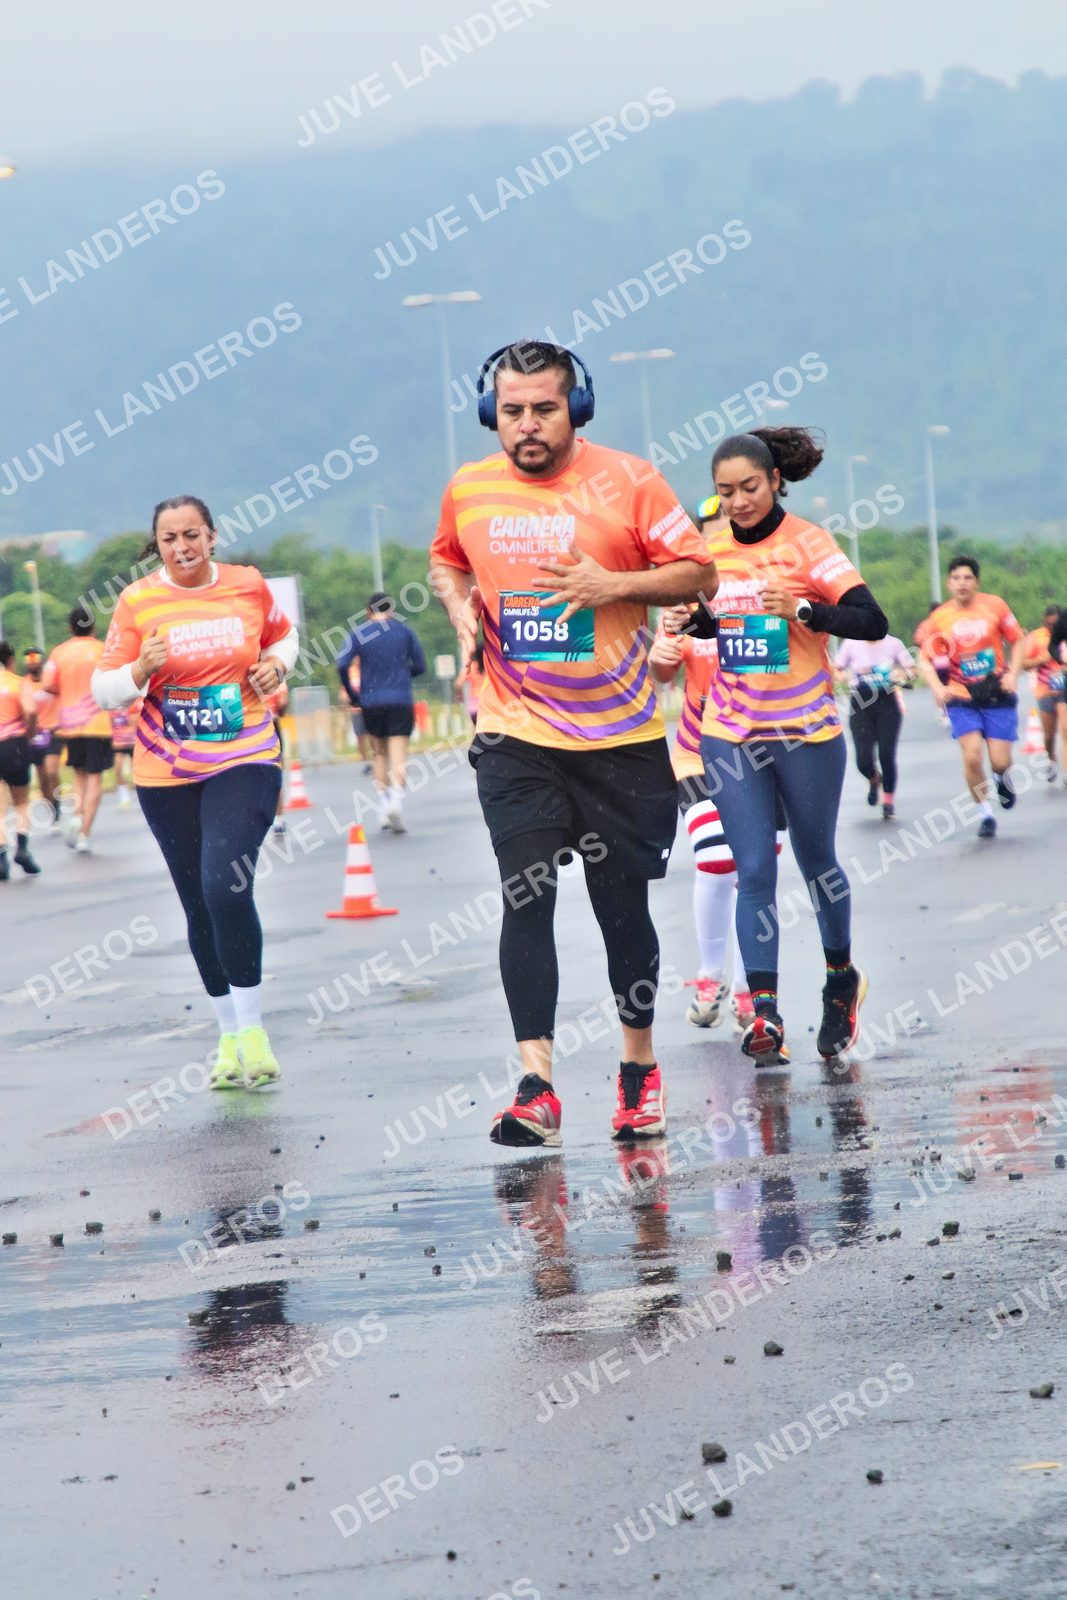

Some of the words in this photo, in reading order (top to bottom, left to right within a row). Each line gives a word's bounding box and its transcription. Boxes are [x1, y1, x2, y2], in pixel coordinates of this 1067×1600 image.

[489, 514, 576, 538] CARRERA
[489, 539, 555, 554] OMNILIFE
[504, 597, 541, 608] CARRERA
[503, 608, 531, 616] OMNILIFE
[169, 616, 243, 644] CARRERA
[512, 620, 569, 642] 1058
[764, 618, 781, 631] 10K
[171, 634, 232, 656] OMNILIFE
[726, 638, 769, 658] 1125
[167, 698, 192, 706] OMNILIFE
[168, 689, 199, 700] CARRERA
[176, 708, 223, 726] 1121
